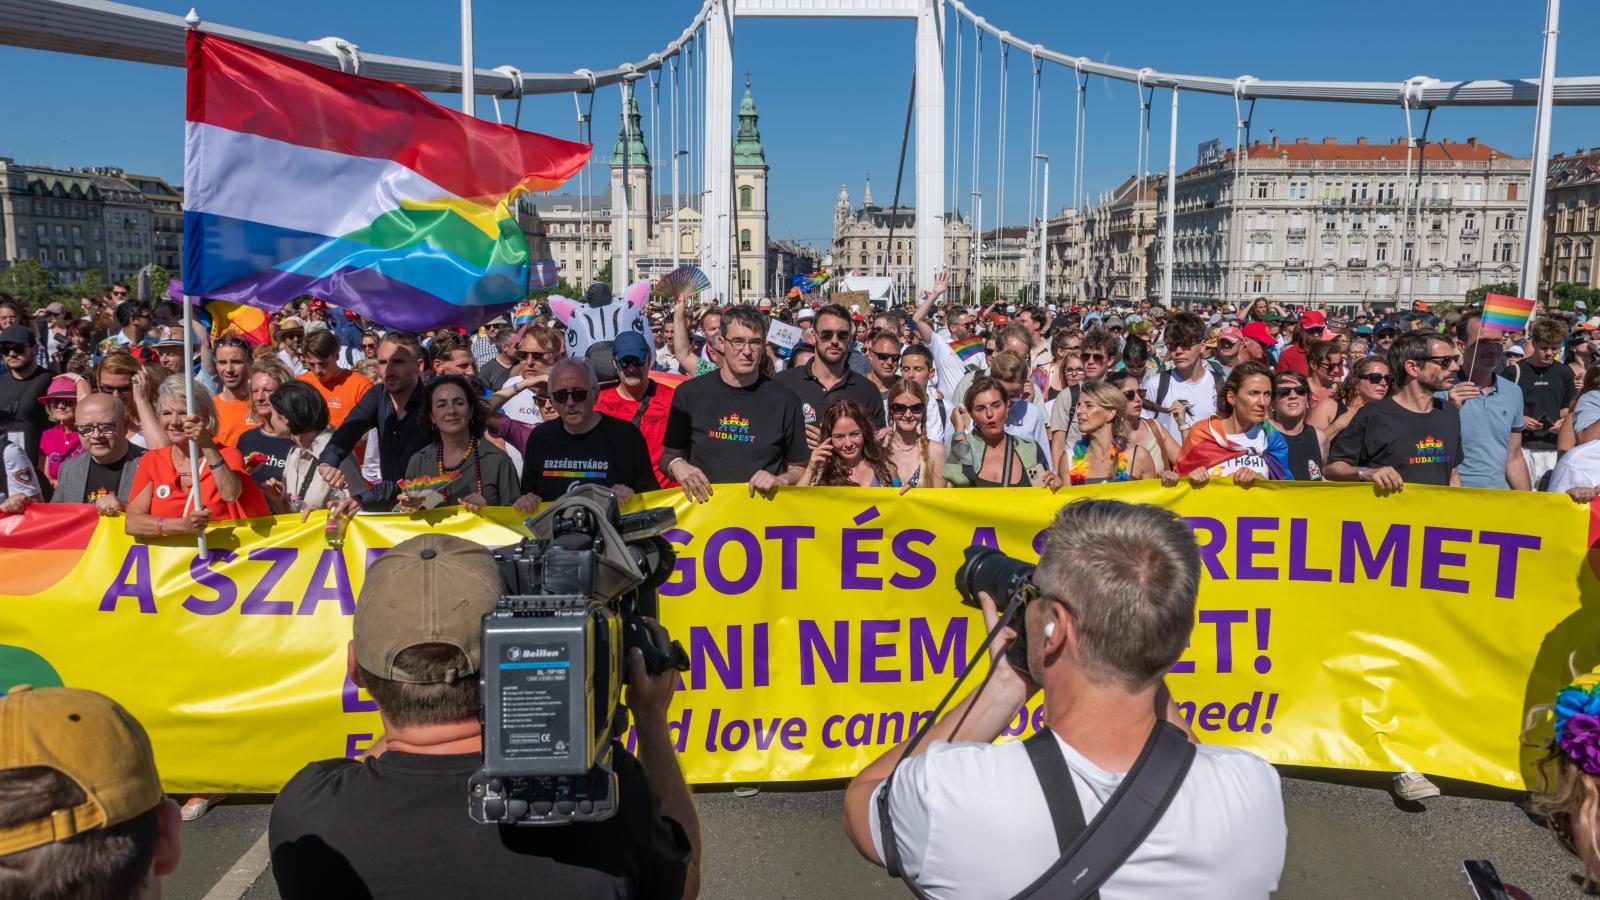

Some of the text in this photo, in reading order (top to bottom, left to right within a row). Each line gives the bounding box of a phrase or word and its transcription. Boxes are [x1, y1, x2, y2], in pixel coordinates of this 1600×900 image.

[709, 430, 755, 443] BUDAPEST
[543, 457, 609, 470] ERZSÉBETVÁROS
[1235, 455, 1265, 468] FIGHT
[1409, 455, 1451, 465] BUDAPEST
[99, 544, 158, 614] A
[841, 506, 937, 590] ÉS
[522, 649, 559, 658] Beillen
[799, 617, 969, 686] NEM
[705, 709, 807, 752] love
